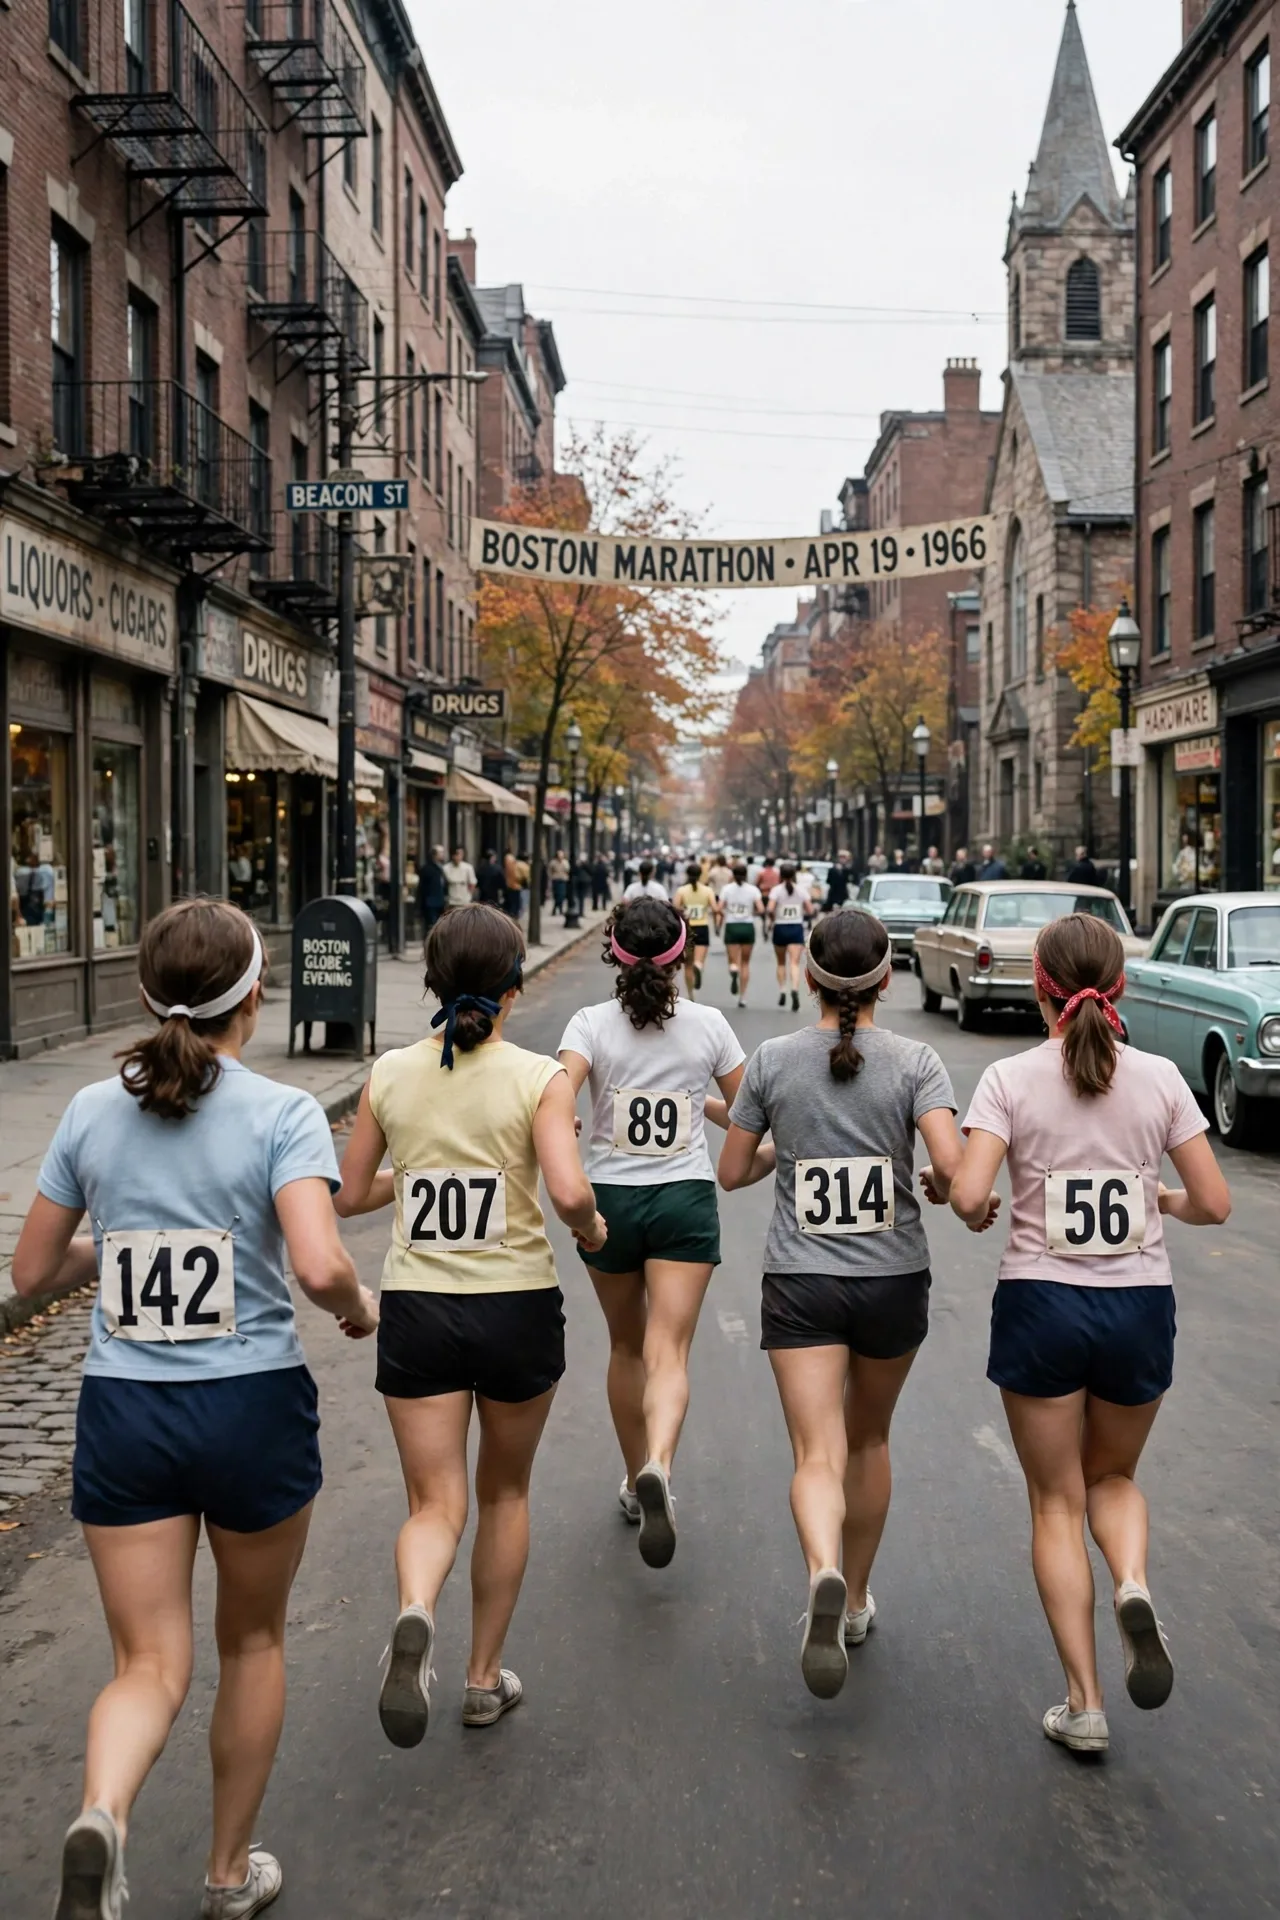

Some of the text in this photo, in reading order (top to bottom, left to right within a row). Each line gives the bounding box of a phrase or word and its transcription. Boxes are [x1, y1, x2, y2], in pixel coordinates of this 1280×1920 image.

[292, 484, 405, 507] BEACON ST
[482, 525, 987, 582] BOSTON MARATHON APR 19 1966
[7, 535, 94, 622] LIQUORS
[109, 581, 167, 649] CIGARS
[243, 631, 307, 697] DRUGS
[432, 694, 500, 715] DRUGS
[1144, 696, 1209, 735] HARDWARE
[302, 939, 351, 955] BOSTON
[302, 970, 353, 987] EVENING
[628, 1097, 678, 1149] 89
[411, 1178, 497, 1241] 207
[804, 1165, 888, 1225] 314
[1065, 1178, 1130, 1246] 56
[117, 1245, 220, 1326] 142
